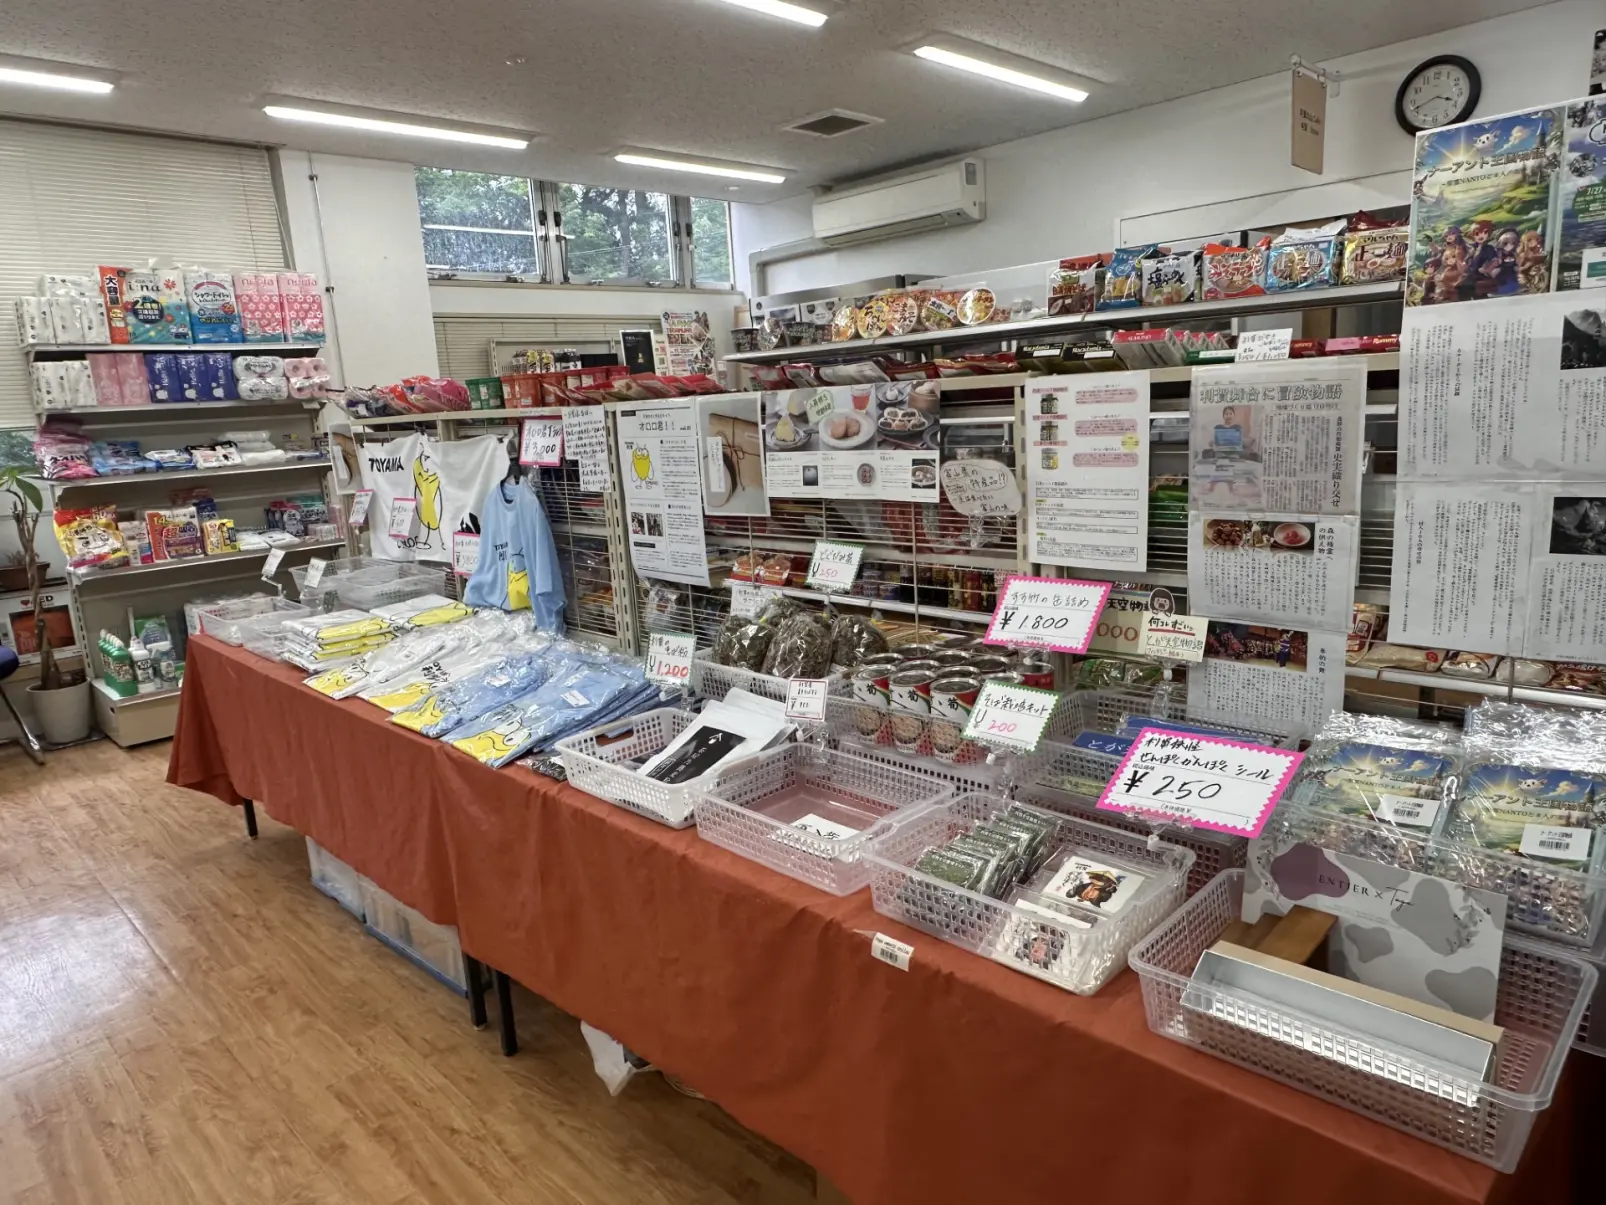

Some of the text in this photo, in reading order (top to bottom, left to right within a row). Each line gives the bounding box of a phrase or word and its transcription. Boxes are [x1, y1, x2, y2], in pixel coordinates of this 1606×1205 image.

[368, 456, 404, 472] TOYAMA
[1000, 611, 1015, 630] ¥
[1123, 769, 1222, 800] ¥ 250
